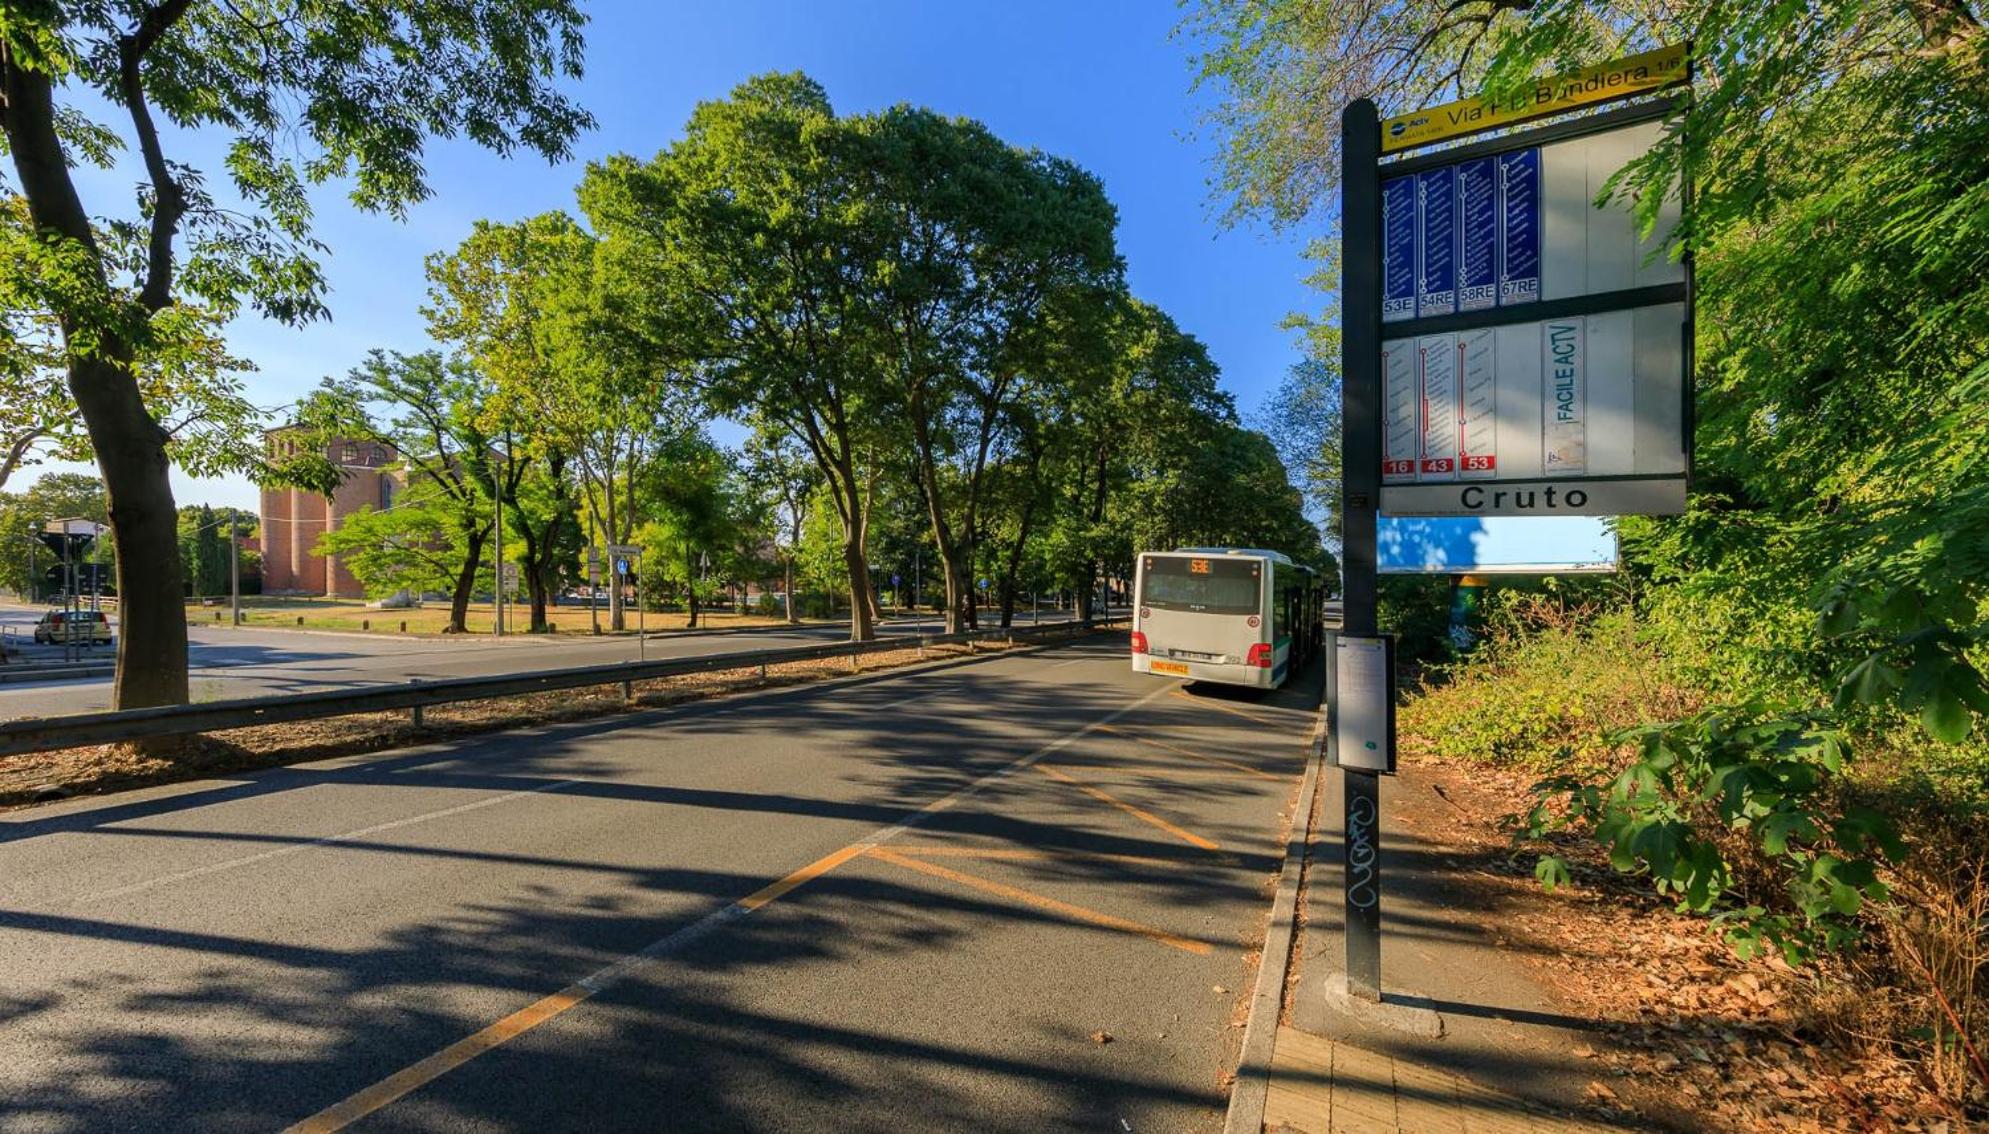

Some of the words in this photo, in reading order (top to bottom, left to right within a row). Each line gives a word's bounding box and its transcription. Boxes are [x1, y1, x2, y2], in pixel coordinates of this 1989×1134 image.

[1447, 107, 1482, 127] Via
[1461, 286, 1494, 301] 58RE
[1502, 279, 1538, 295] 67RE
[1384, 300, 1412, 313] 53E
[1421, 291, 1454, 307] 54RE
[1549, 325, 1577, 366] ACTV
[1555, 367, 1575, 422] FACILE
[1389, 461, 1409, 473] 16
[1427, 459, 1448, 472] 43
[1468, 457, 1489, 470] 53
[1460, 485, 1589, 509] Cruto
[1191, 559, 1209, 574] 53E
